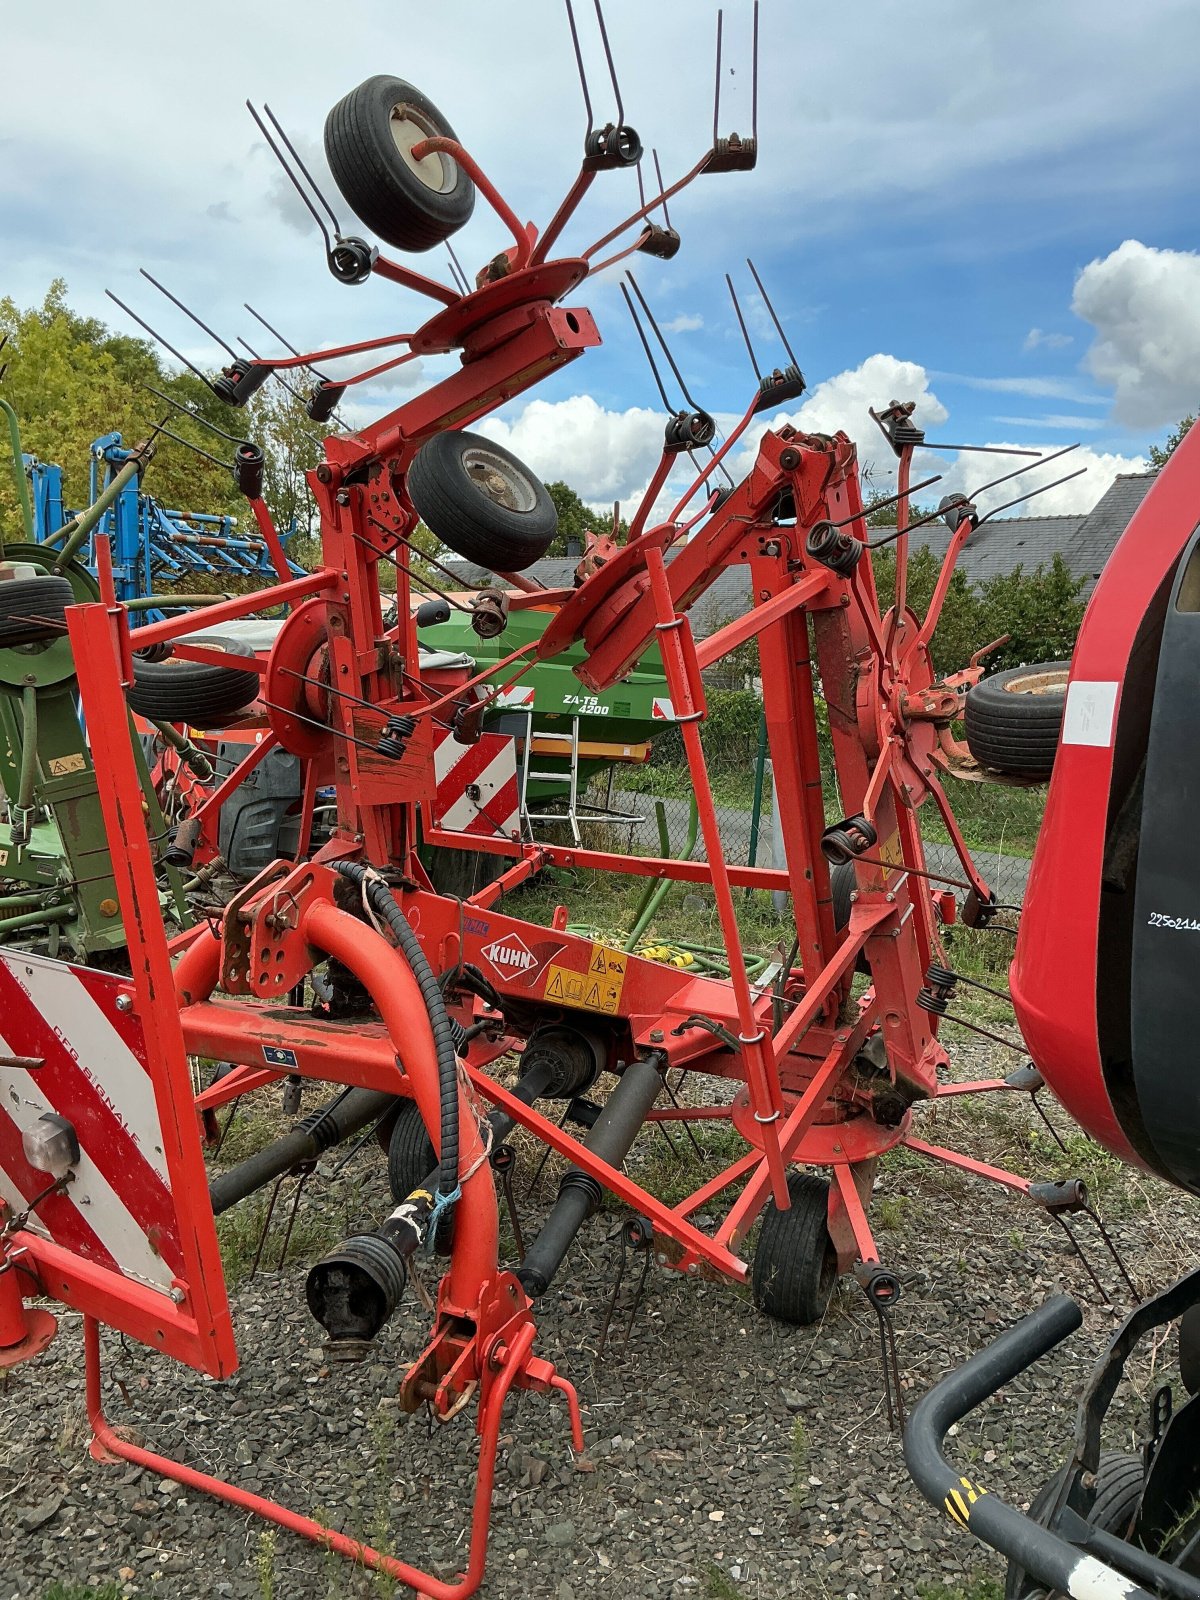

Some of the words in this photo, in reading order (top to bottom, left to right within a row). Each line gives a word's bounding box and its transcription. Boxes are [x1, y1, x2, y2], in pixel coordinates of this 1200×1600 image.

[562, 694, 599, 706] ZA-TS
[578, 705, 609, 715] 4200
[489, 944, 531, 969] KUHN
[53, 1025, 80, 1061] CFG
